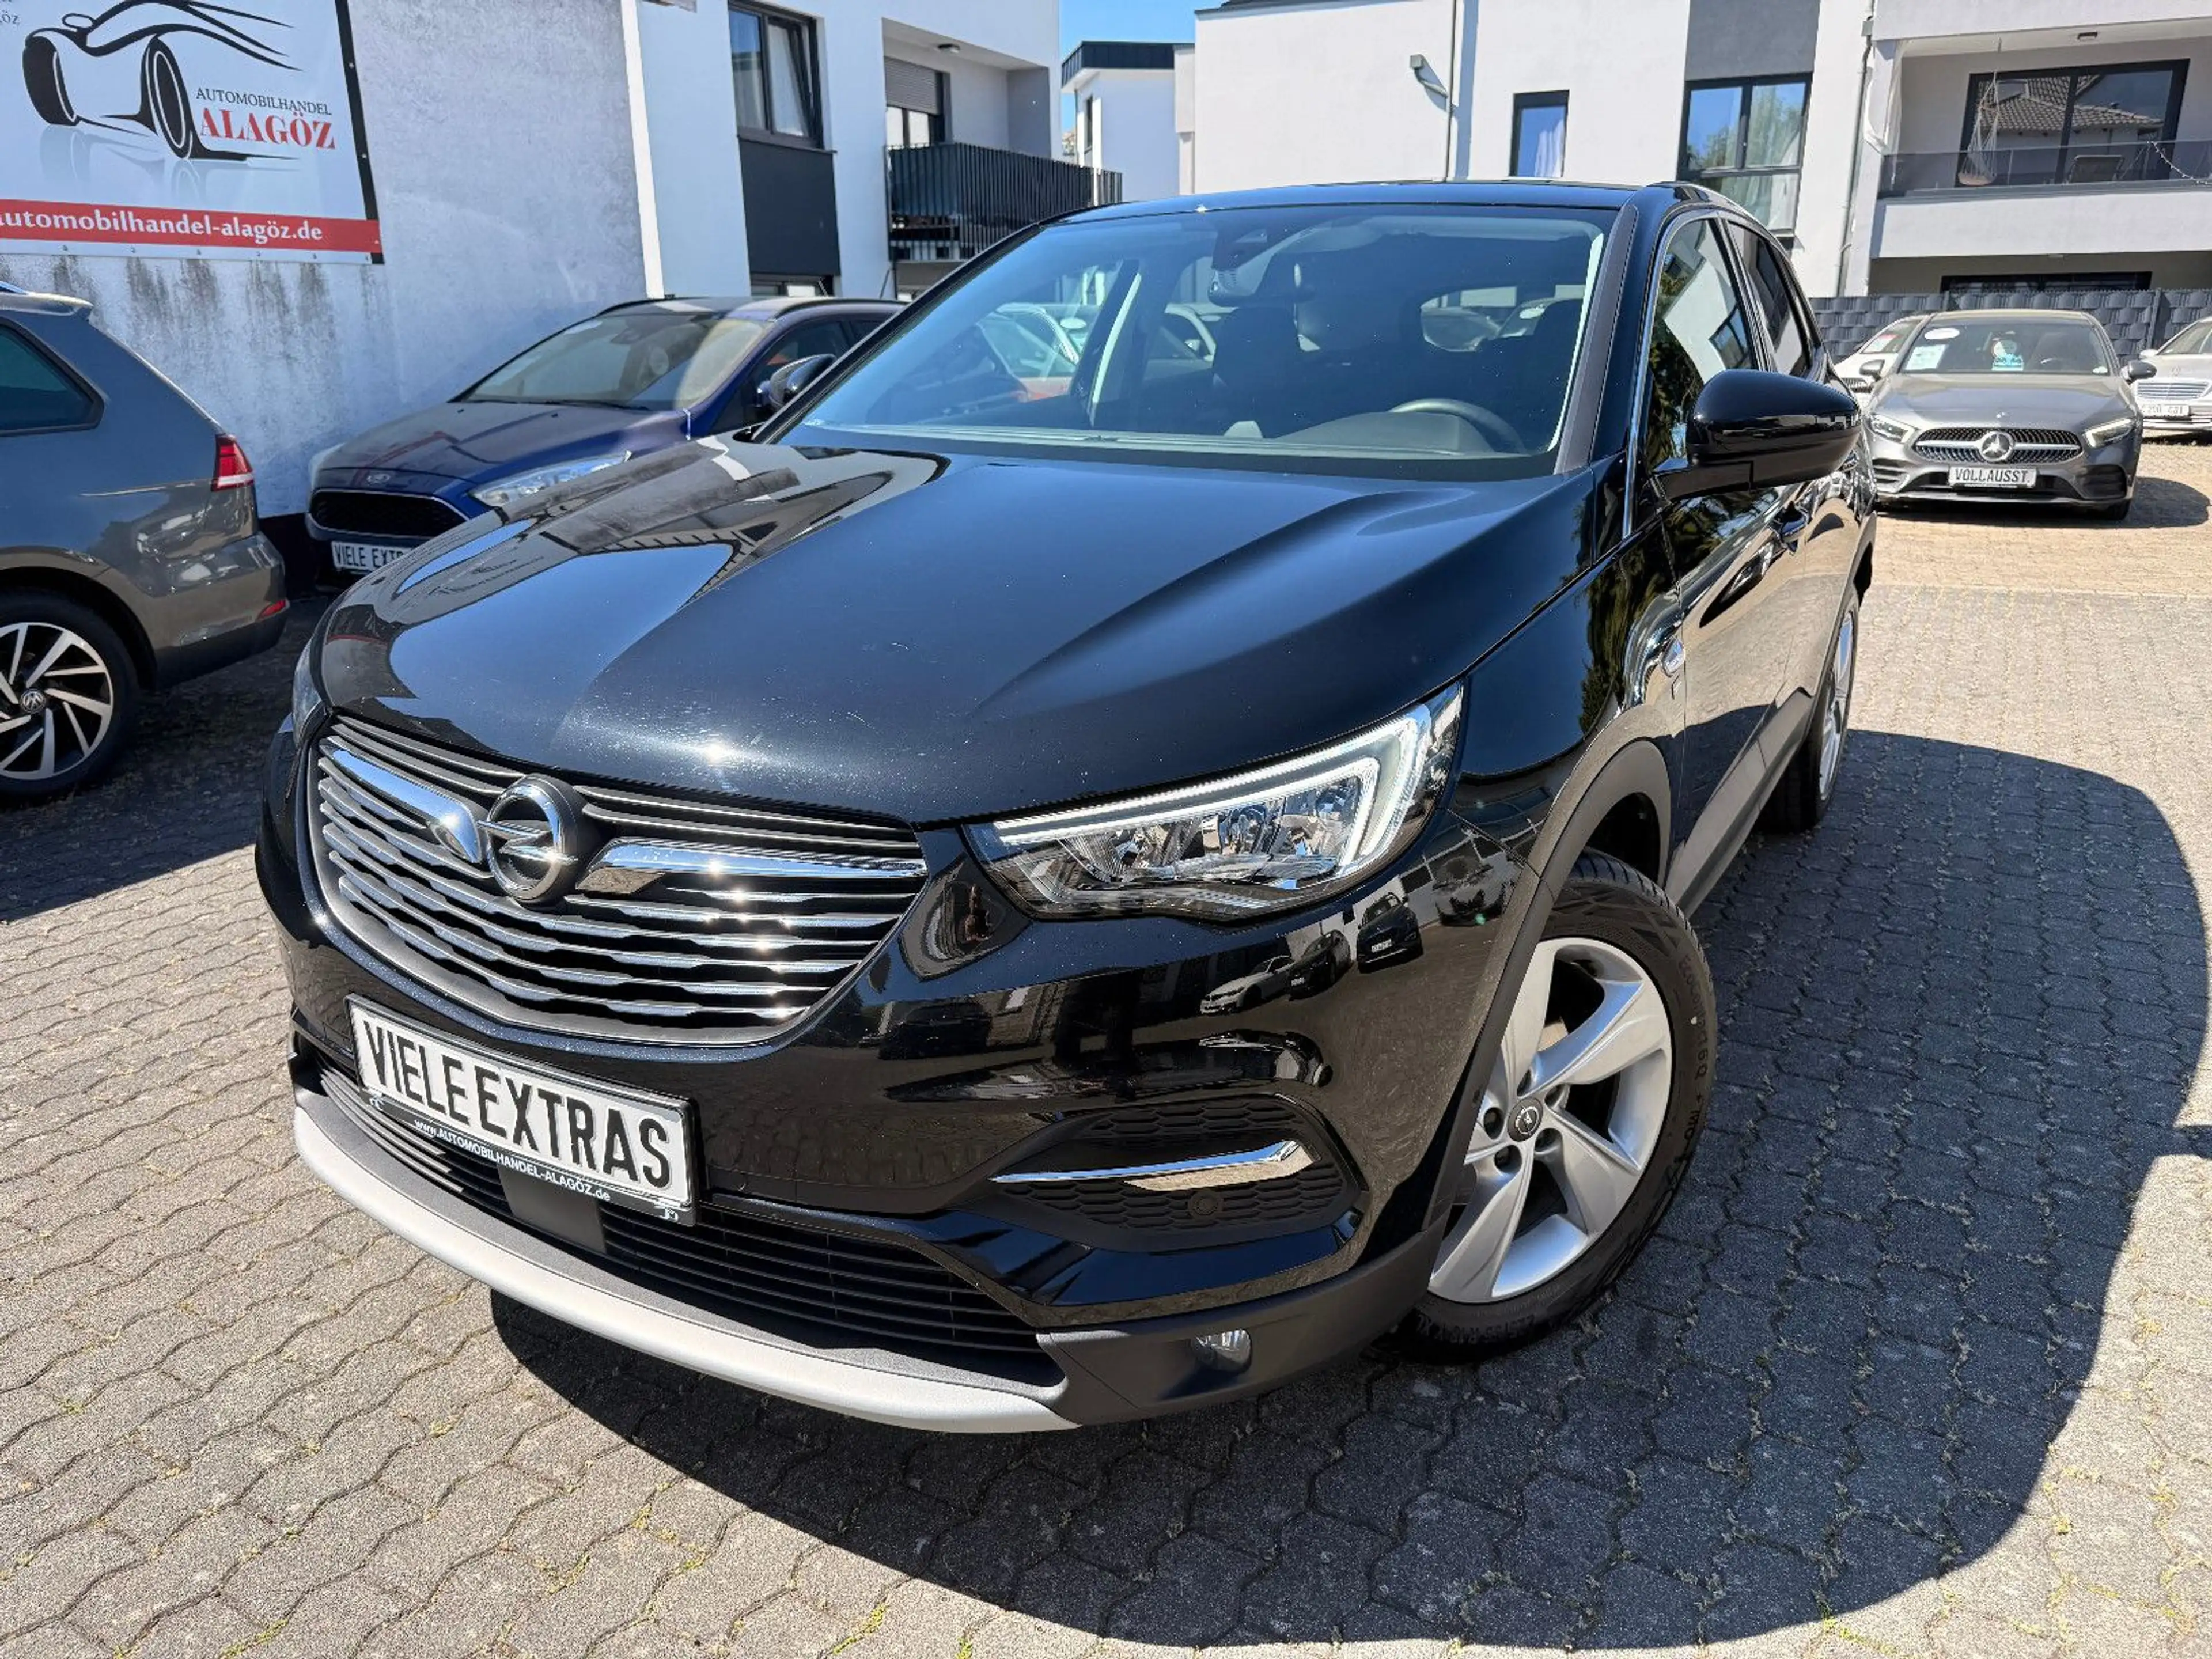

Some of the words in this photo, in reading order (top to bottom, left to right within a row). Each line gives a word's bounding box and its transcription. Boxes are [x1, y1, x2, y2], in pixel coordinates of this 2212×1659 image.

[196, 87, 332, 116] AUTOMOBILHANDEL
[200, 108, 336, 150] ALAGÖZ
[1955, 467, 2031, 483] VOLLAUSST.
[334, 544, 366, 567] VIELE
[414, 1118, 610, 1202] www.AUTOMOBILHANDEL-ALAGÖZ.de
